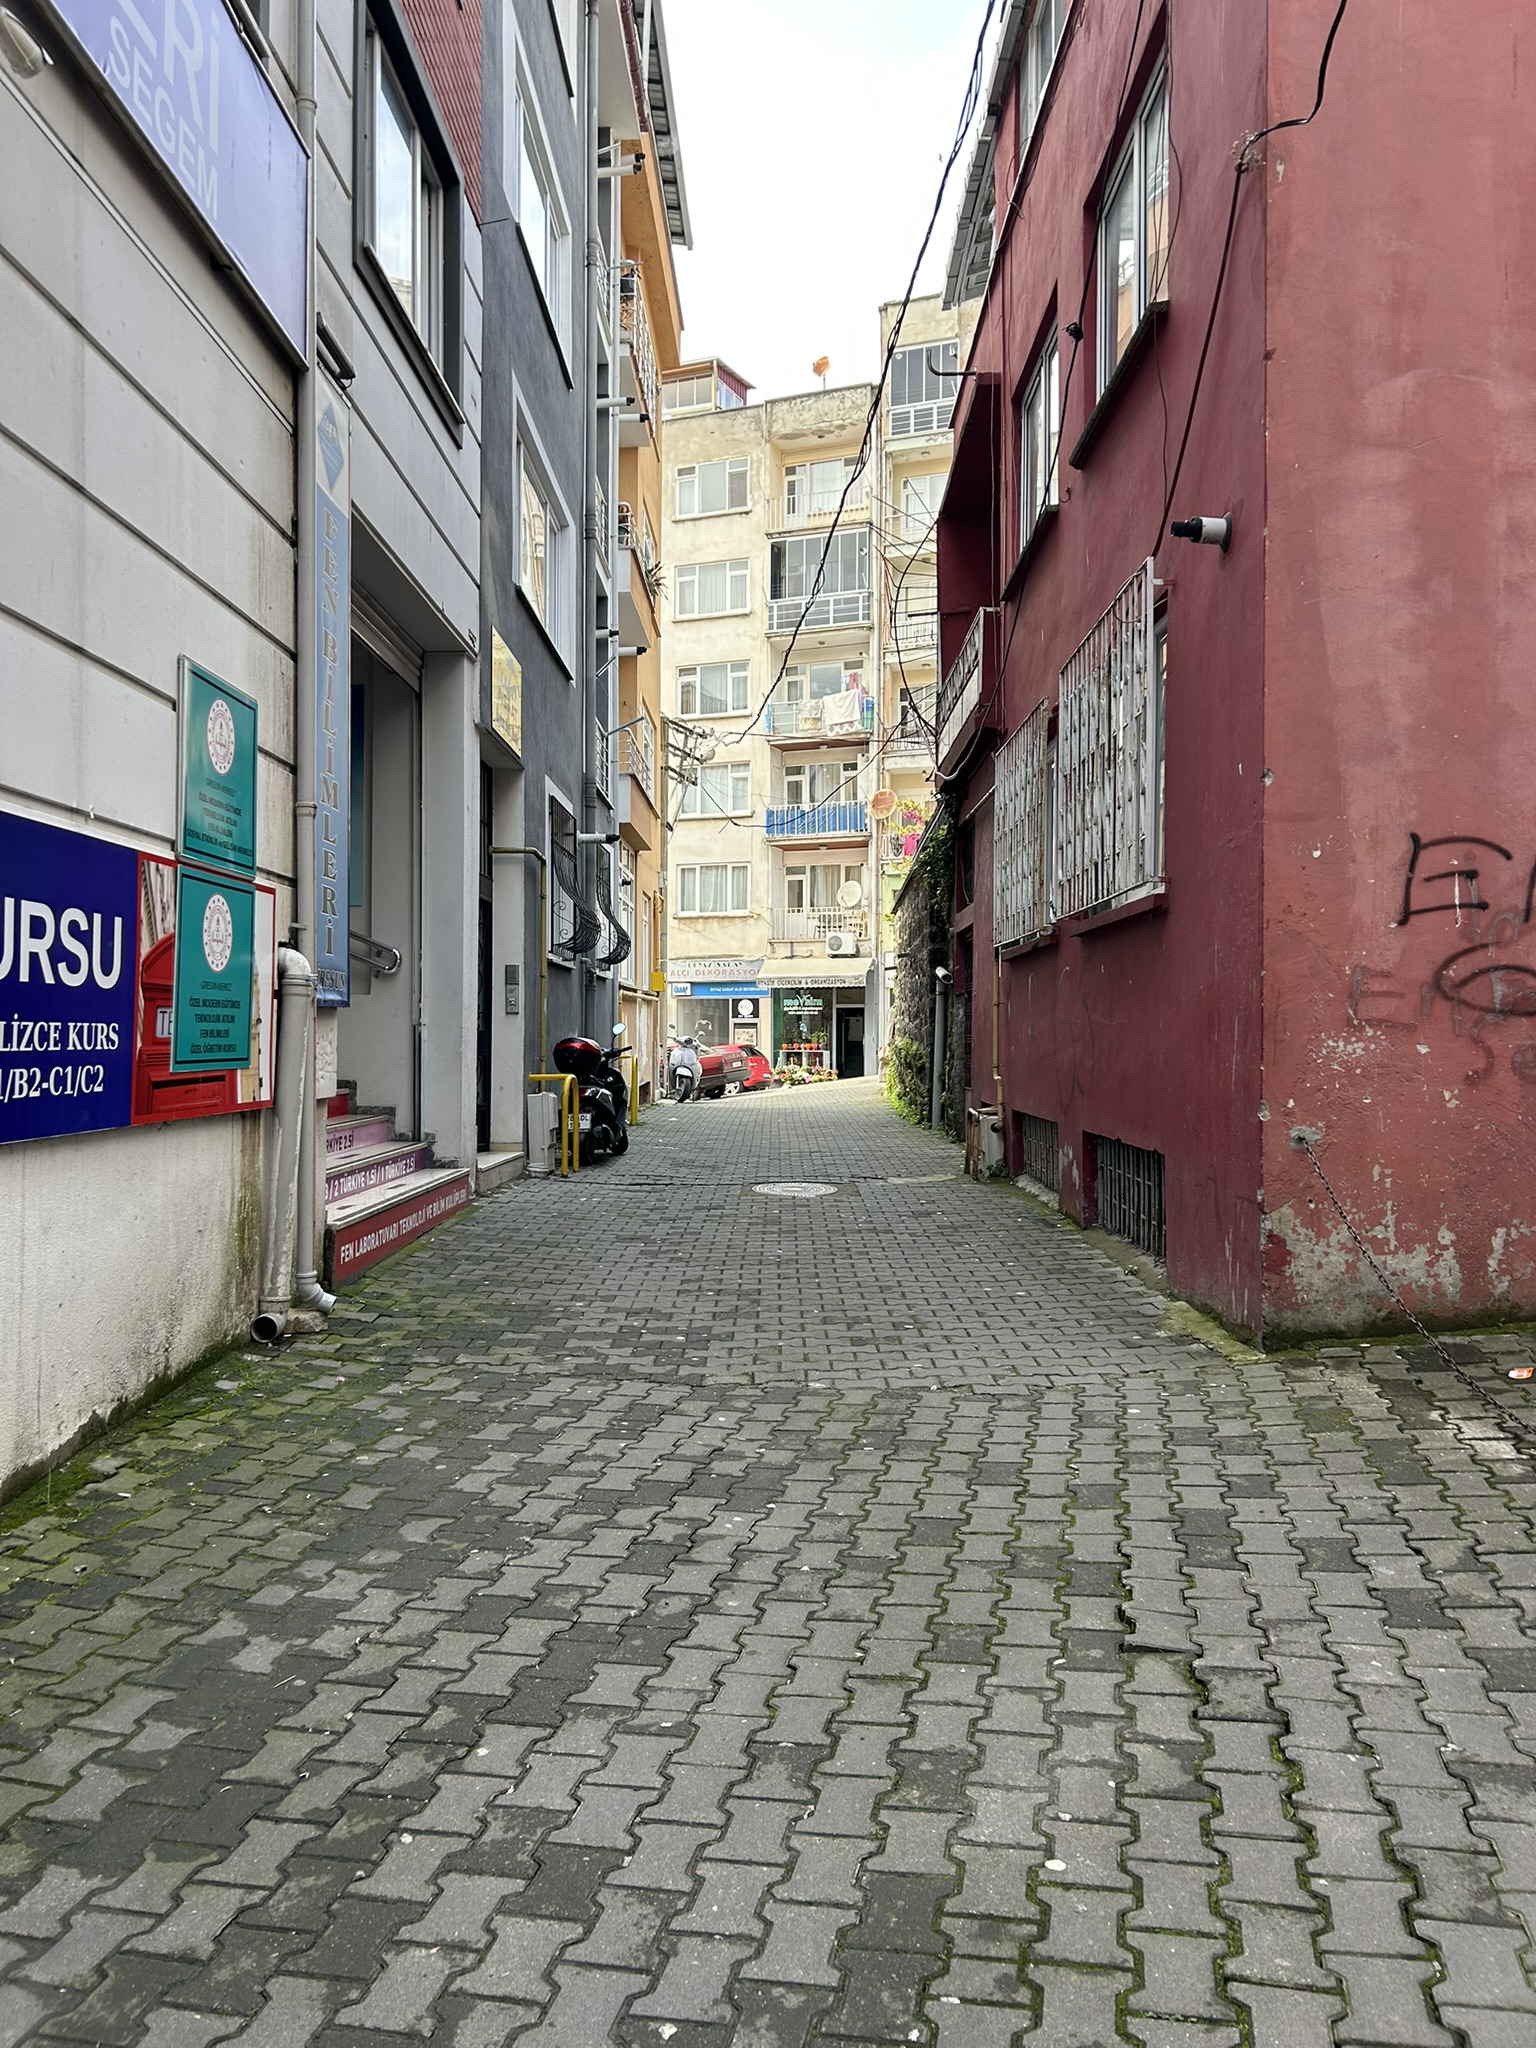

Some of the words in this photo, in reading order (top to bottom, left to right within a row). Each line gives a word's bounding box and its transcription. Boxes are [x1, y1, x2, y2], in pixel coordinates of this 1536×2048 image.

[108, 16, 218, 221] SEGEM
[117, 0, 219, 155] Rİ
[322, 507, 340, 621] FEN
[320, 626, 340, 957] BİLİMLERİ
[67, 1022, 119, 1050] KURS
[340, 1170, 366, 1194] TÜRKİYE
[385, 1158, 406, 1180] TÜRKİYE
[340, 1241, 354, 1265] FEN
[354, 1220, 399, 1258] LABORATUVARI
[399, 1204, 426, 1236] TEKNOLOJİ
[426, 1203, 433, 1220] VE
[432, 1197, 446, 1217] BİLİM
